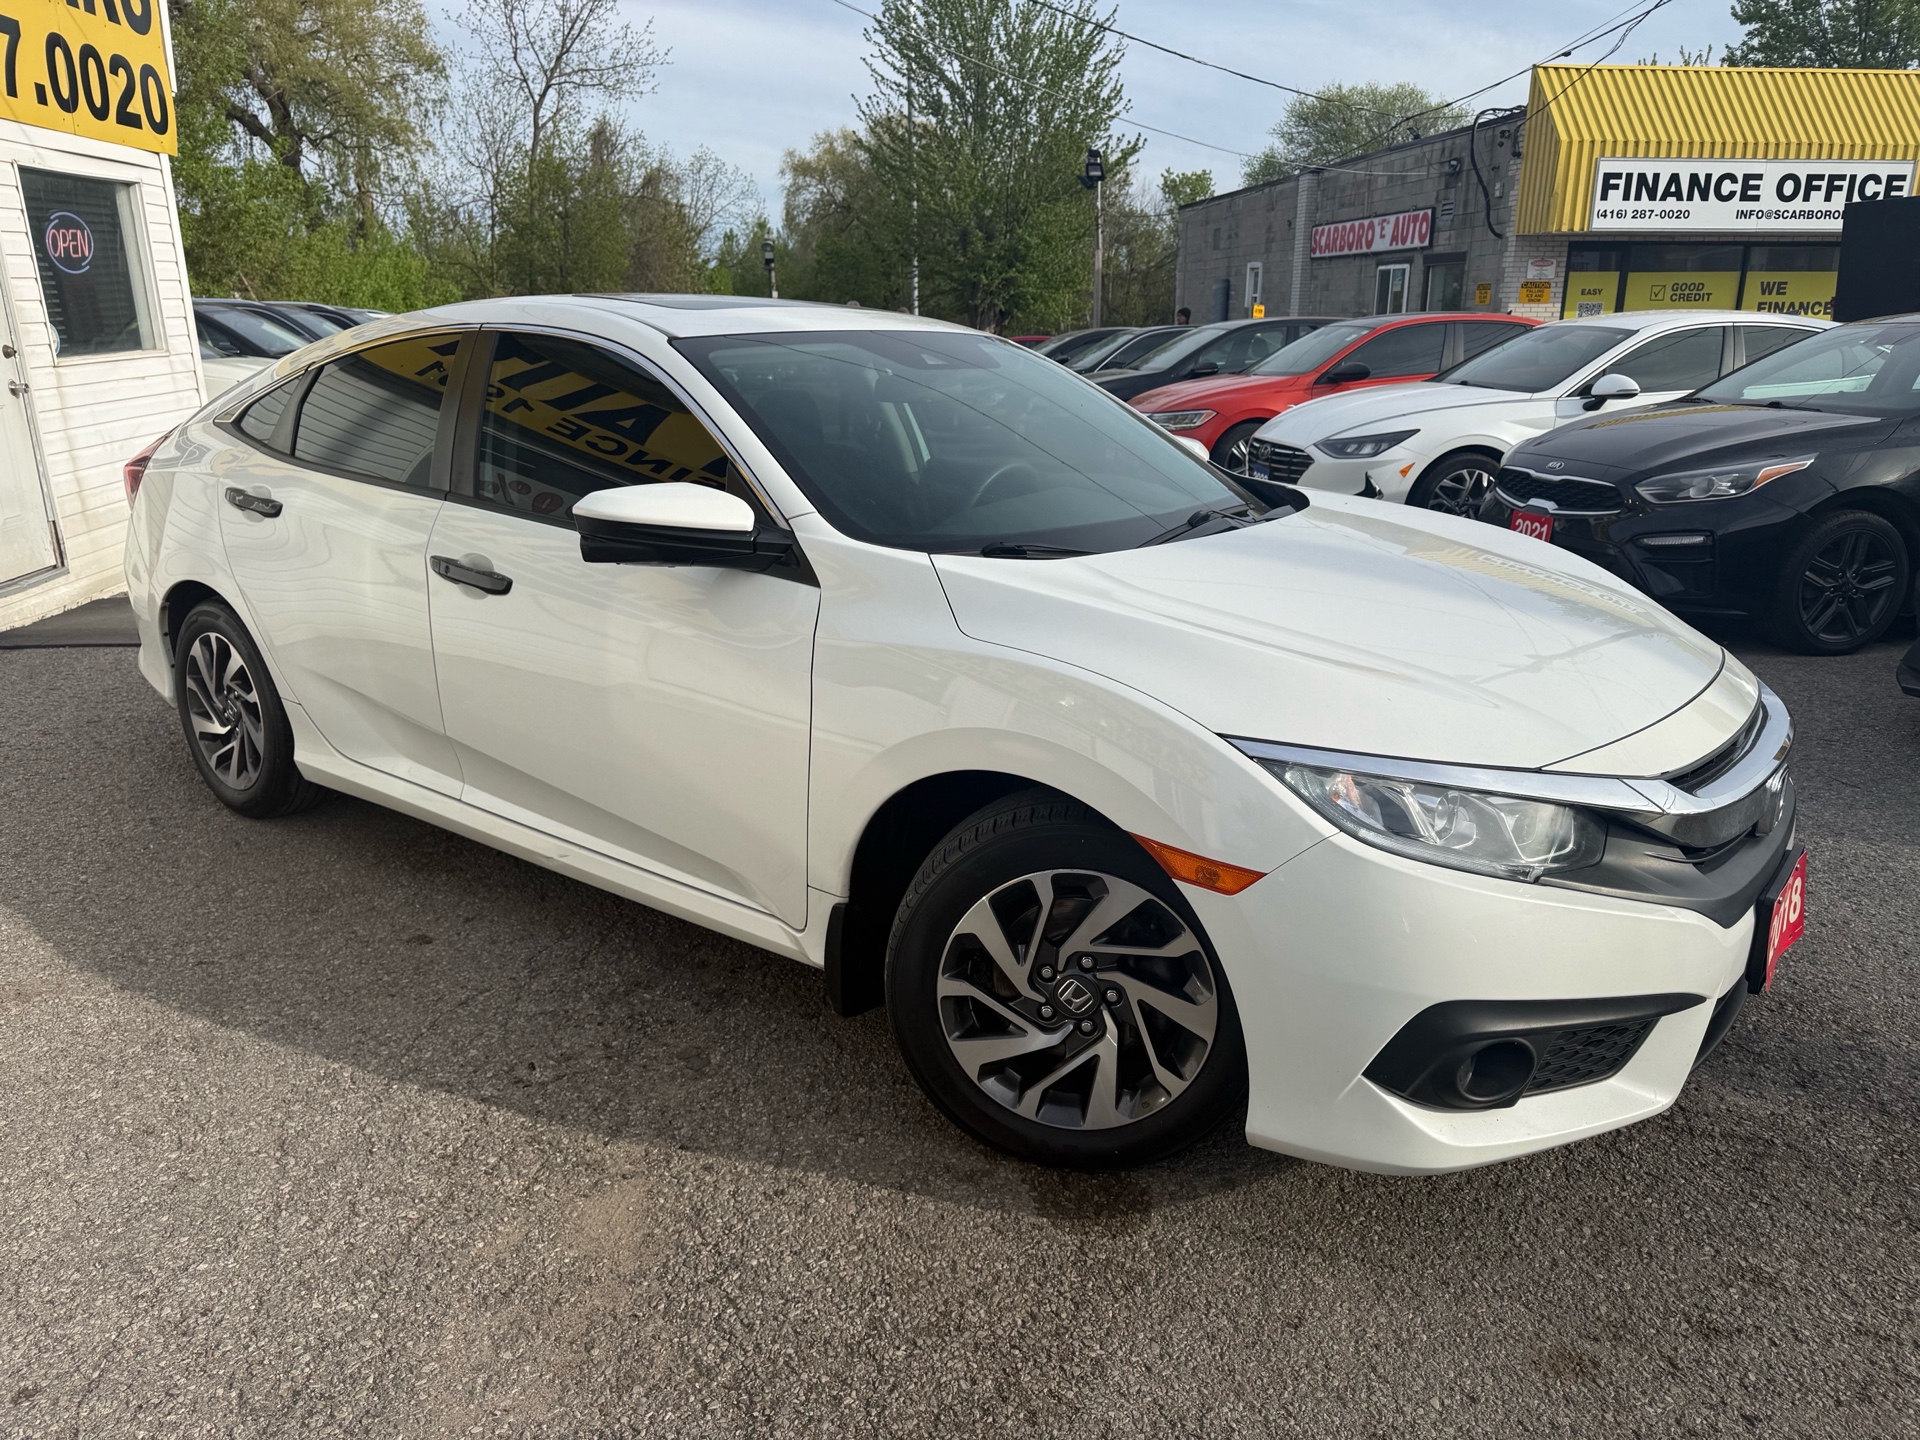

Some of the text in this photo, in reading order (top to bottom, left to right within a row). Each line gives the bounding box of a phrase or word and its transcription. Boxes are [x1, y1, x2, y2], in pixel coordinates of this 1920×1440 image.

[0, 14, 169, 136] 7.0020
[1599, 172, 1908, 203] FINANCE OFFICE
[1596, 209, 1691, 220] (416) 287-0020
[1311, 219, 1376, 256] SCARBORO
[1388, 211, 1431, 247] AUTO
[49, 229, 90, 258] OPEN
[1580, 288, 1603, 296] EASY
[1670, 282, 1705, 292] GOOD
[1759, 281, 1789, 296] WE
[1669, 293, 1713, 303] CREDIT
[1756, 301, 1833, 316] FINANCE
[1515, 518, 1549, 541] 2021
